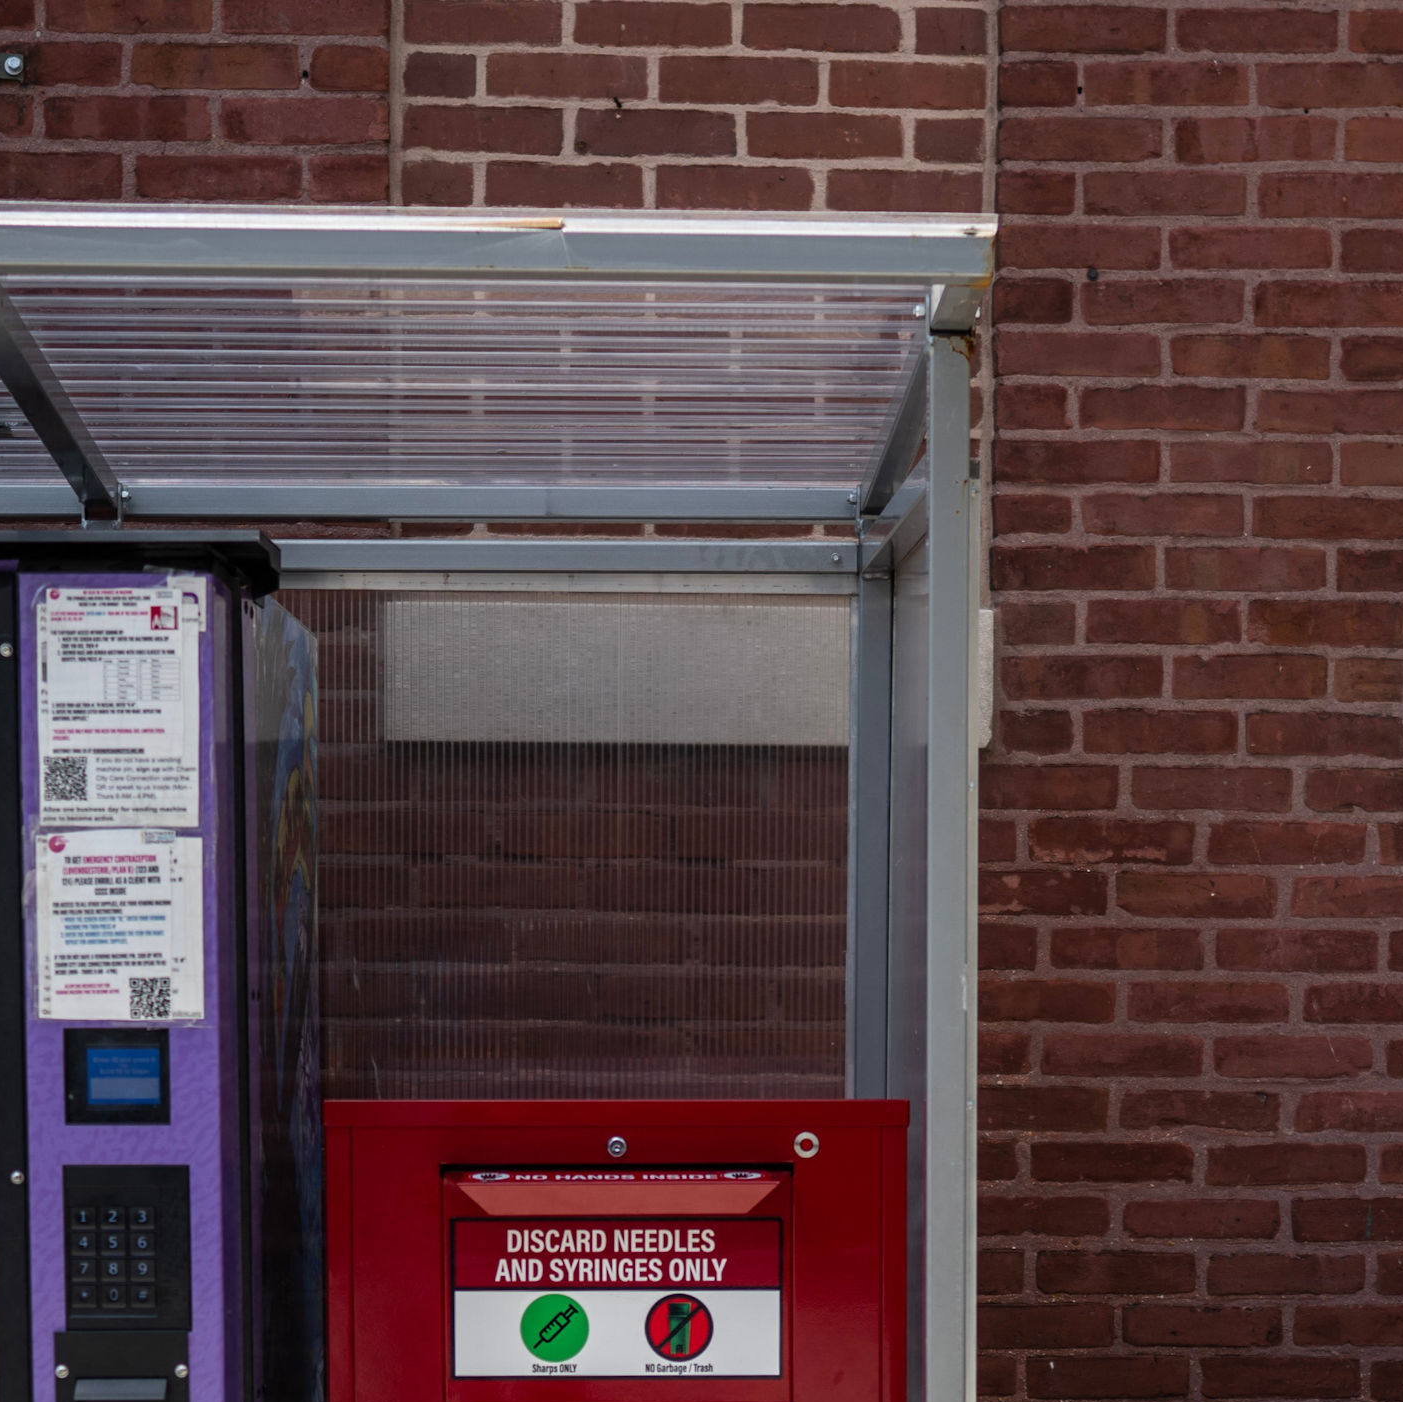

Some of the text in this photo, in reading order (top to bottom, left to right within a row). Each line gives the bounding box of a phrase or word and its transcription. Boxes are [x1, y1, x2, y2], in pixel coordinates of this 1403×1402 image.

[79, 1210, 147, 1222] 1 2 3
[79, 1237, 147, 1248] 4 5 6
[506, 1228, 716, 1253] DISCARD NEEDLES
[79, 1263, 147, 1275] 7 8 9
[494, 1258, 728, 1283] AND SYRINGES ONLY
[531, 1363, 577, 1376] Sharps ONLY
[644, 1363, 713, 1376] NO Garbage Trash
